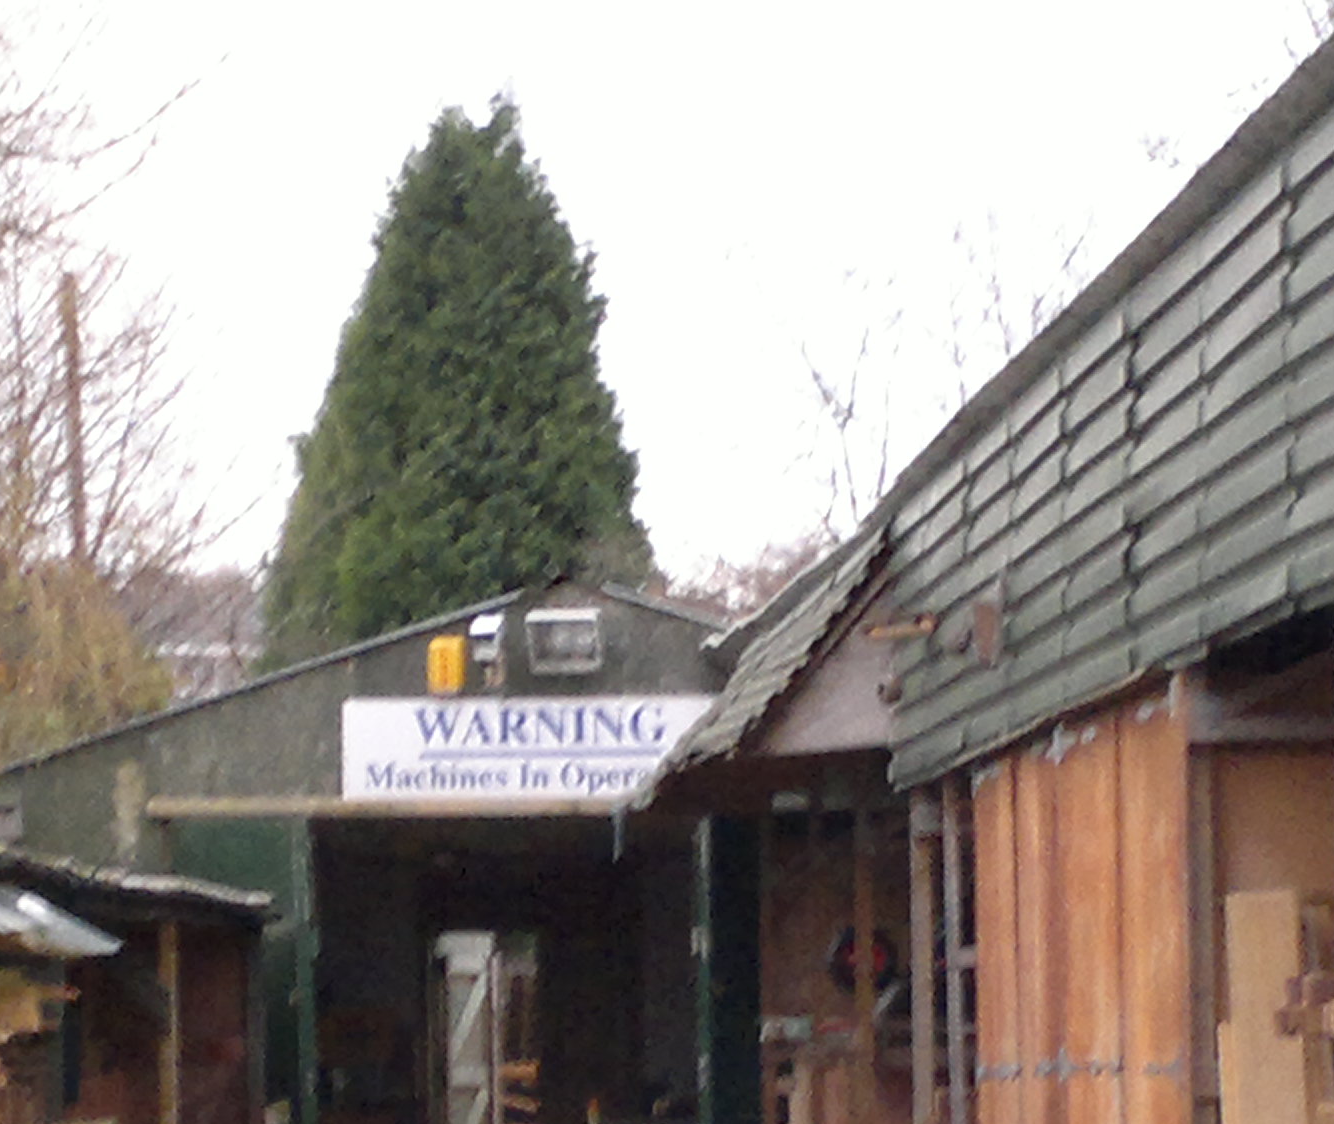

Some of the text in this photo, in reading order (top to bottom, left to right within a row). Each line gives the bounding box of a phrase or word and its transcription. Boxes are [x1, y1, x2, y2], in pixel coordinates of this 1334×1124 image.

[415, 705, 665, 745] WARNING
[366, 760, 508, 790] Machines
[519, 760, 549, 788] In
